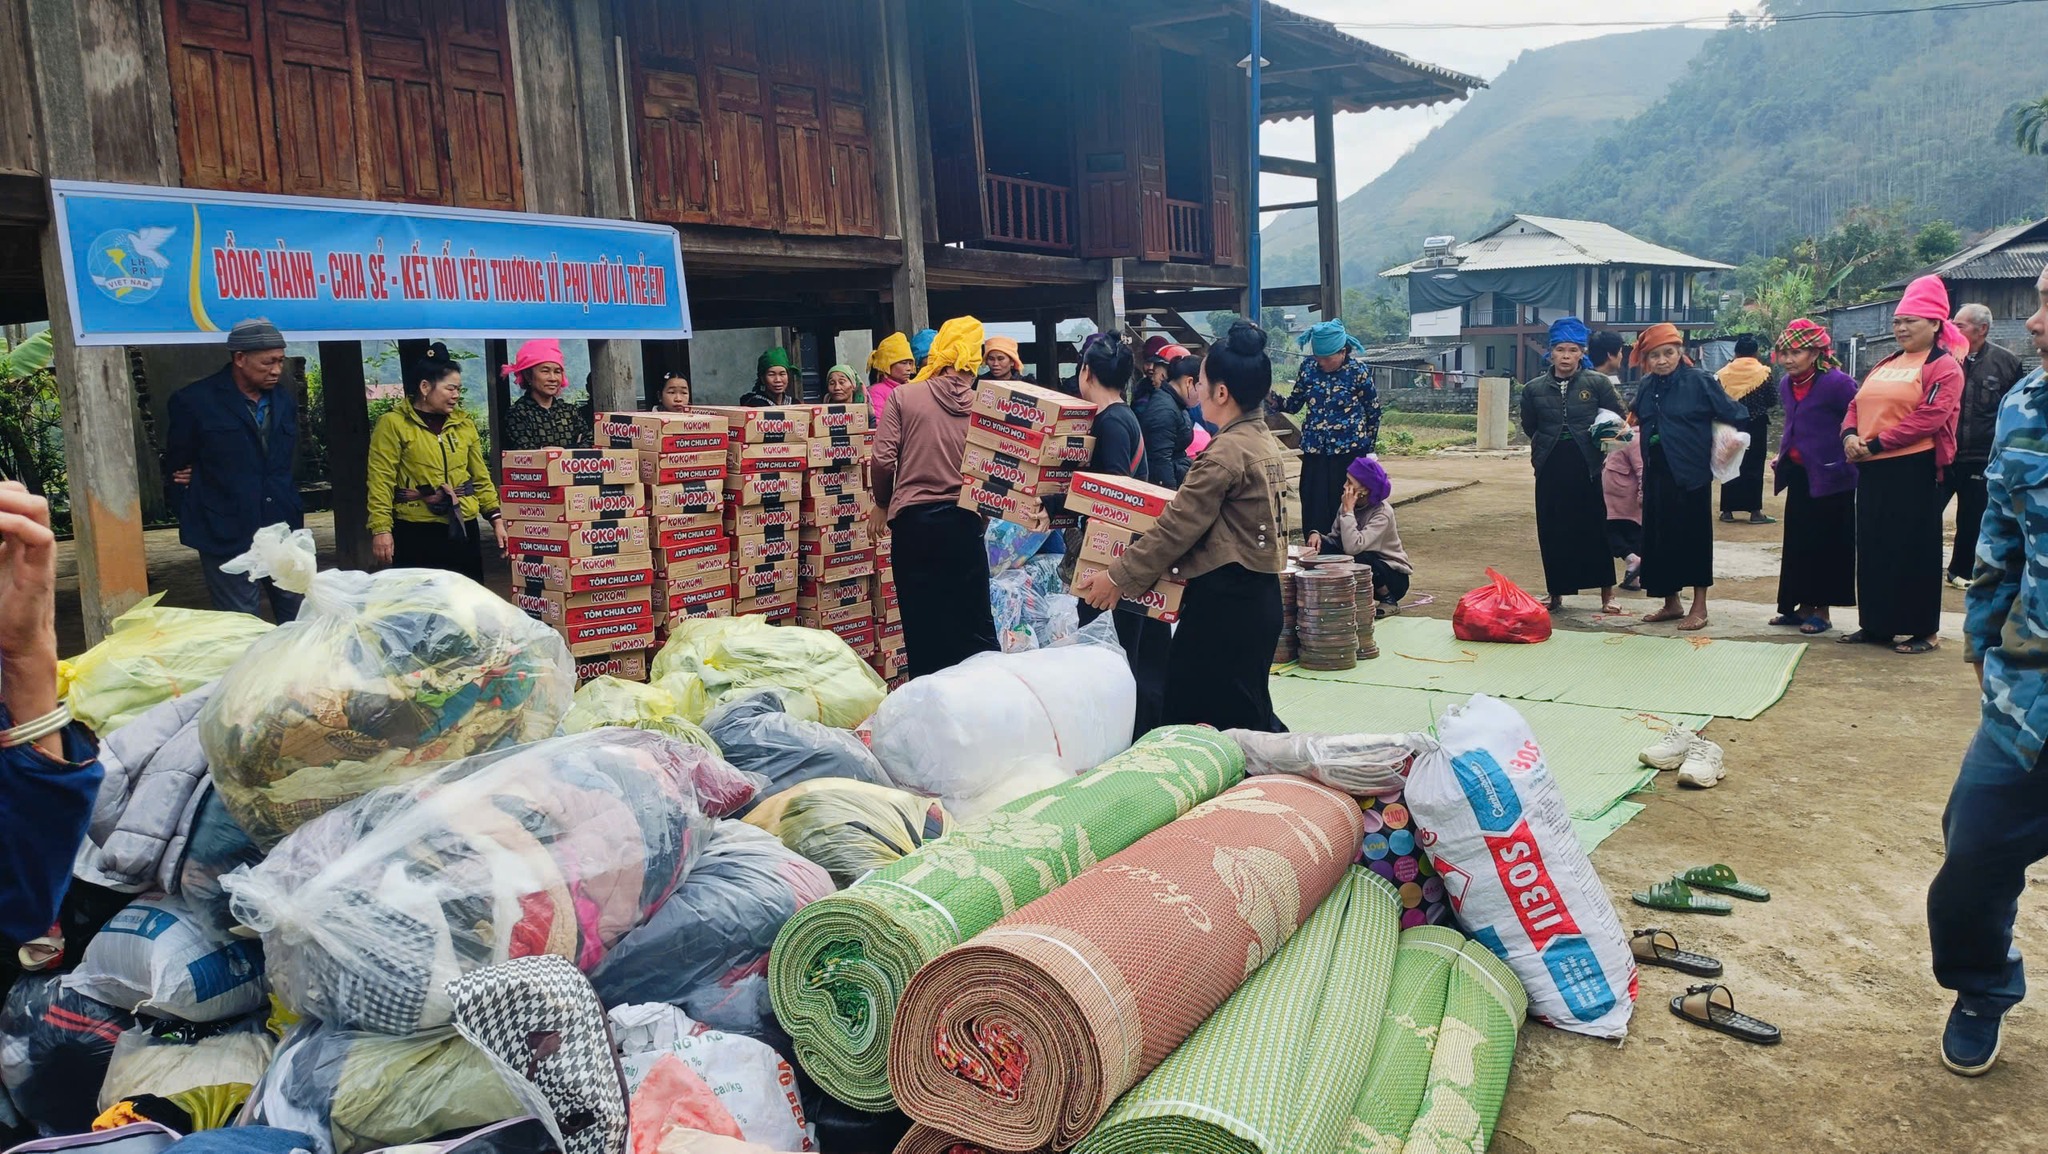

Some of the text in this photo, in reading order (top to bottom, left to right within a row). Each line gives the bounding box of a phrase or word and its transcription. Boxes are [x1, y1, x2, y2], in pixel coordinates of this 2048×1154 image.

[132, 267, 147, 275] PN
[213, 231, 266, 299] ĐỒNG
[267, 240, 317, 299] HÀNH
[328, 251, 367, 299] CHIA
[369, 238, 389, 300] SẺ
[400, 241, 431, 300] KẾT
[460, 249, 489, 301] YÊU
[490, 256, 546, 303] THƯƠNG
[546, 252, 561, 303] VÌ
[562, 262, 589, 313] PHỤ
[590, 254, 609, 304] NỮ
[609, 255, 628, 305] VÀ
[628, 252, 648, 306] TRẺ
[648, 265, 666, 306] EM
[130, 279, 149, 288] NAM
[996, 398, 1046, 424] KOKOMI
[683, 422, 710, 430] KOKOMI
[822, 413, 853, 426] KOKOMI
[978, 418, 991, 427] CAY
[602, 422, 640, 439] KOKOMI
[756, 420, 794, 433] KOKOMI
[992, 423, 1010, 434] CHUA
[825, 447, 857, 459] KOKOMI
[1000, 440, 1030, 458] KOKOMI
[1058, 447, 1089, 460] KOKOMI
[561, 458, 615, 473] KOKOMI
[668, 455, 698, 463] KOKOMI
[981, 460, 1026, 484] KOKOMI
[817, 472, 847, 486] KOKOMI
[754, 480, 788, 493] KOKOMI
[674, 491, 716, 507] KOKOMI
[971, 488, 1016, 512] KOKOMI
[1081, 481, 1145, 507] TÔM CHUA CAY
[589, 496, 635, 511] KOKOMI
[831, 503, 861, 517] KOKOMI
[756, 511, 792, 526] KOKOMI
[1092, 502, 1130, 523] KOKOMI
[668, 516, 694, 527] KOKOMI
[524, 525, 550, 535] KOKOMI
[581, 527, 629, 544] KOKOMI
[828, 530, 856, 543] KOKOMI
[534, 543, 549, 551] CHUA
[549, 544, 561, 552] CAY
[757, 541, 792, 557] KOKOMI
[517, 561, 551, 579] KOKOMI
[582, 558, 615, 570] KOKOMI
[608, 576, 629, 584] CHUA
[630, 574, 645, 582] CAY
[677, 578, 703, 589] KOKOMI
[748, 570, 782, 587] KOKOMI
[591, 590, 626, 602] KOKOMI
[697, 593, 713, 601] CHUA
[833, 585, 862, 600] KOKOMI
[518, 595, 549, 612] KOKOMI
[755, 595, 780, 606] KOKOMI
[584, 605, 642, 619] TÔM CHUA CAY
[579, 629, 595, 638] CAY
[596, 625, 619, 635] CHUA
[611, 639, 645, 651] KOKOMI
[1385, 809, 1407, 823] LOVE
[1365, 842, 1386, 851] LOVE
[1500, 841, 1563, 931] 1130S
[713, 1082, 743, 1096] cal/kg
